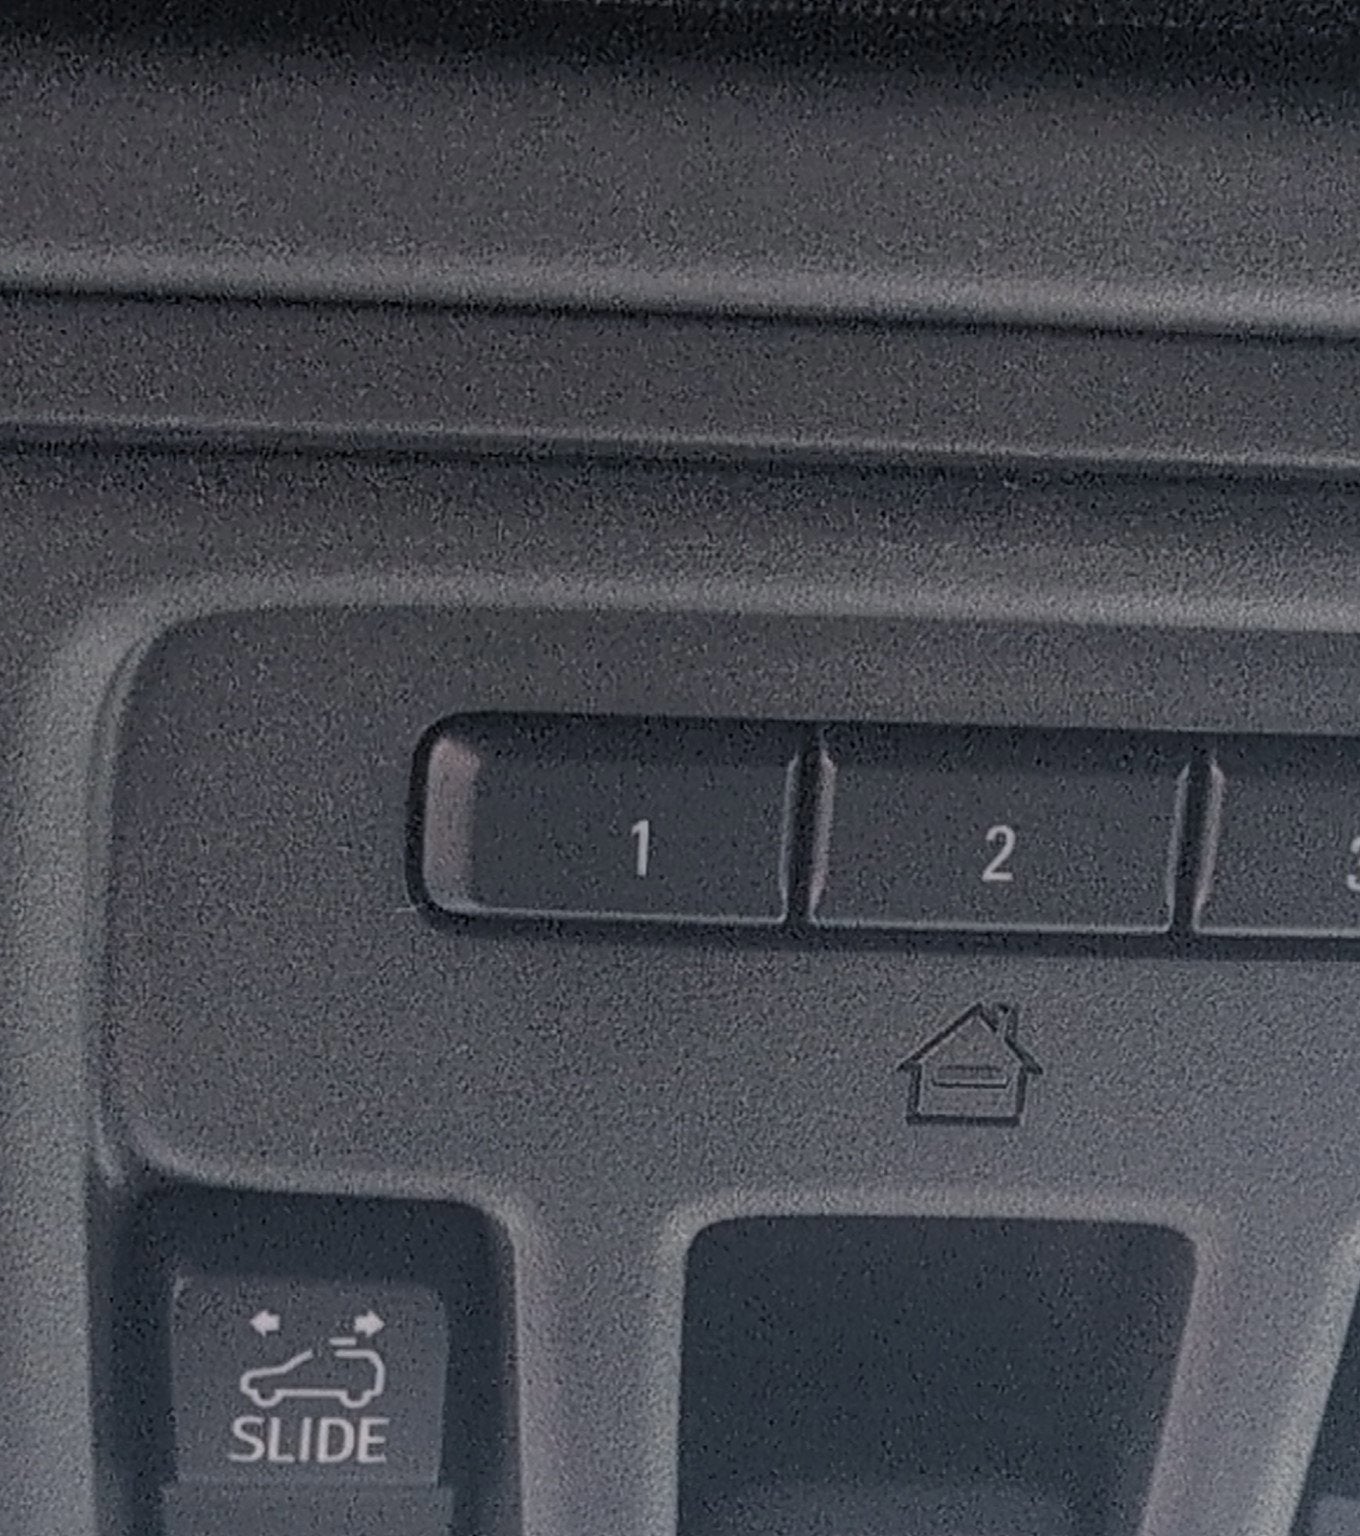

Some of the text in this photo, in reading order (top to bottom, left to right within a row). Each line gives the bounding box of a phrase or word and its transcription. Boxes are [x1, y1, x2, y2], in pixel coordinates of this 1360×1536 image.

[630, 819, 649, 876] 1
[982, 824, 1016, 882] 2
[227, 1415, 390, 1463] SLIDE
